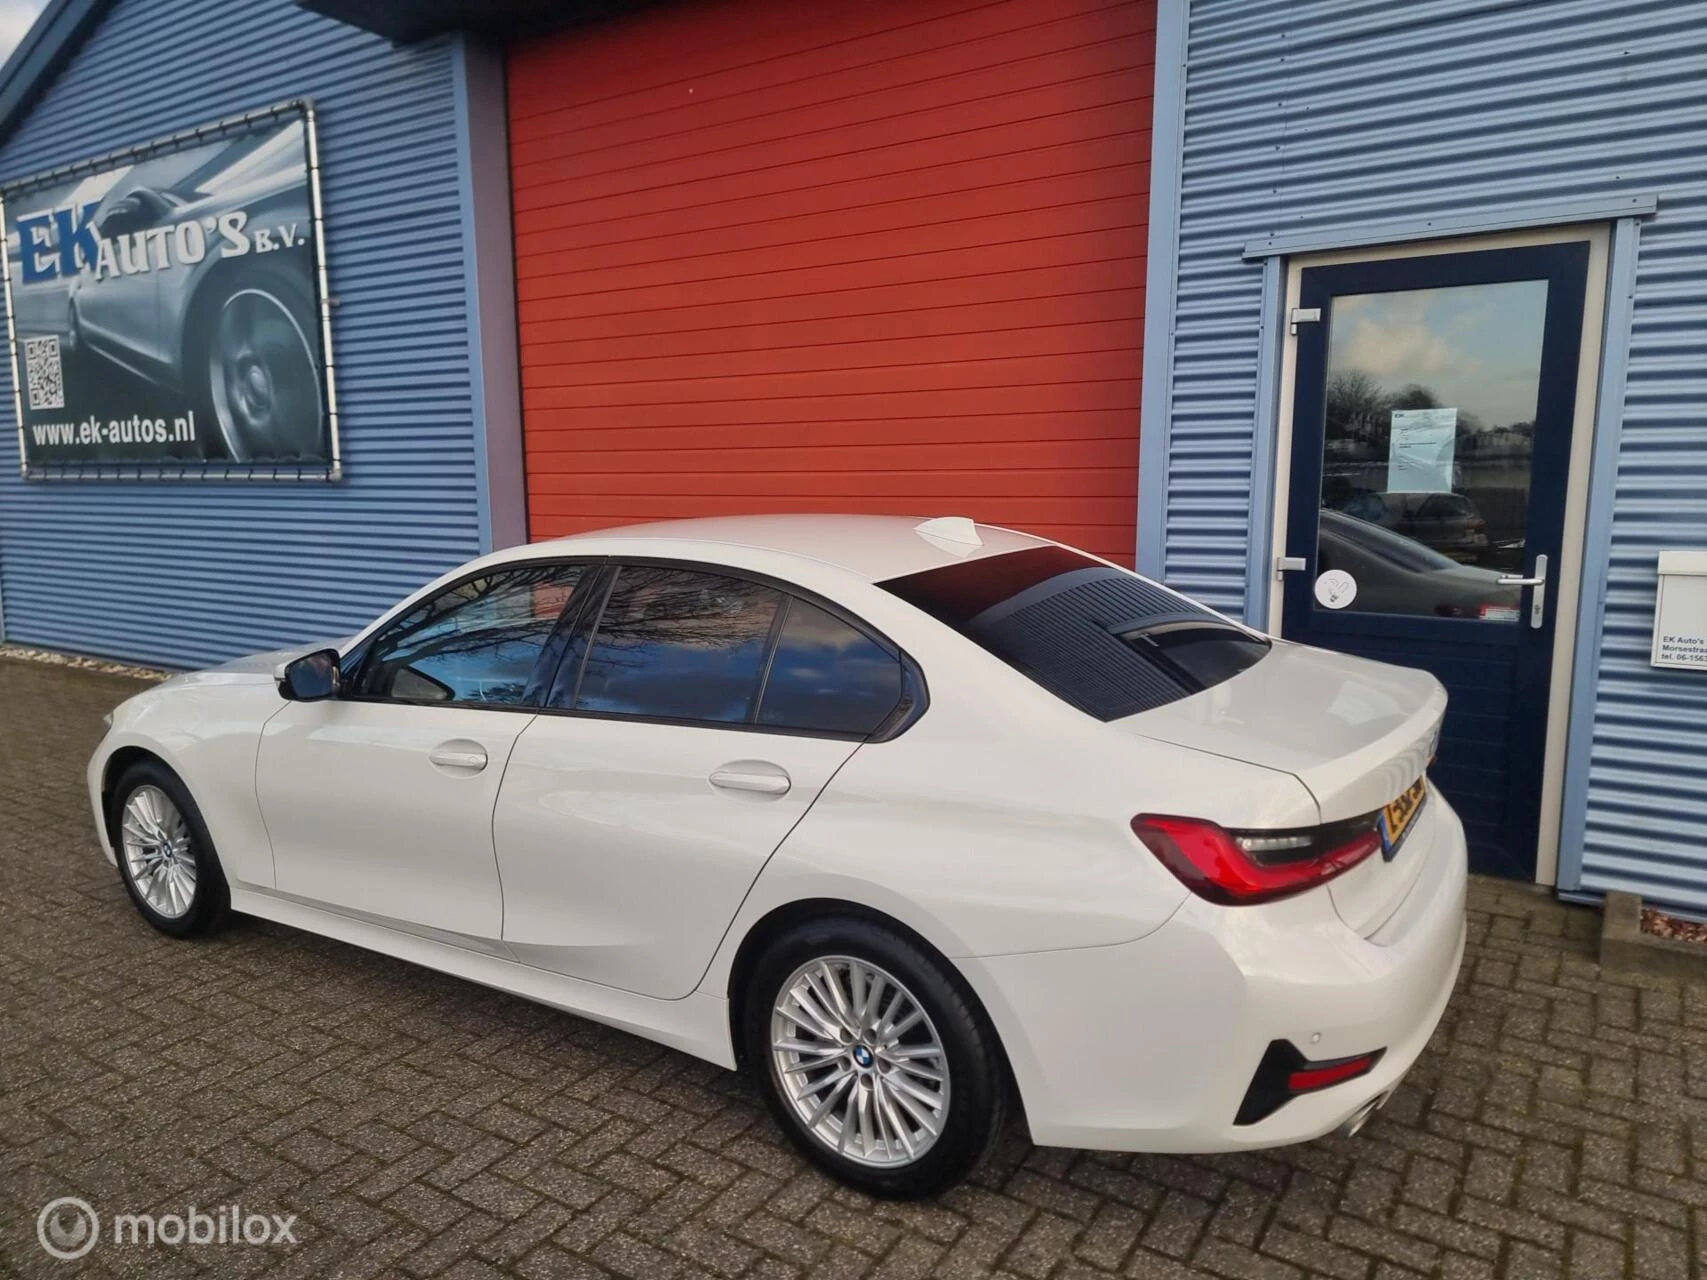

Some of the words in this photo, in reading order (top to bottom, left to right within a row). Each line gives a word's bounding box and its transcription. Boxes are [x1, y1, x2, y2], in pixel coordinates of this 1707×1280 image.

[16, 201, 101, 284] EK
[255, 222, 305, 254] B.V.
[32, 411, 196, 446] www.ek-autos.nl
